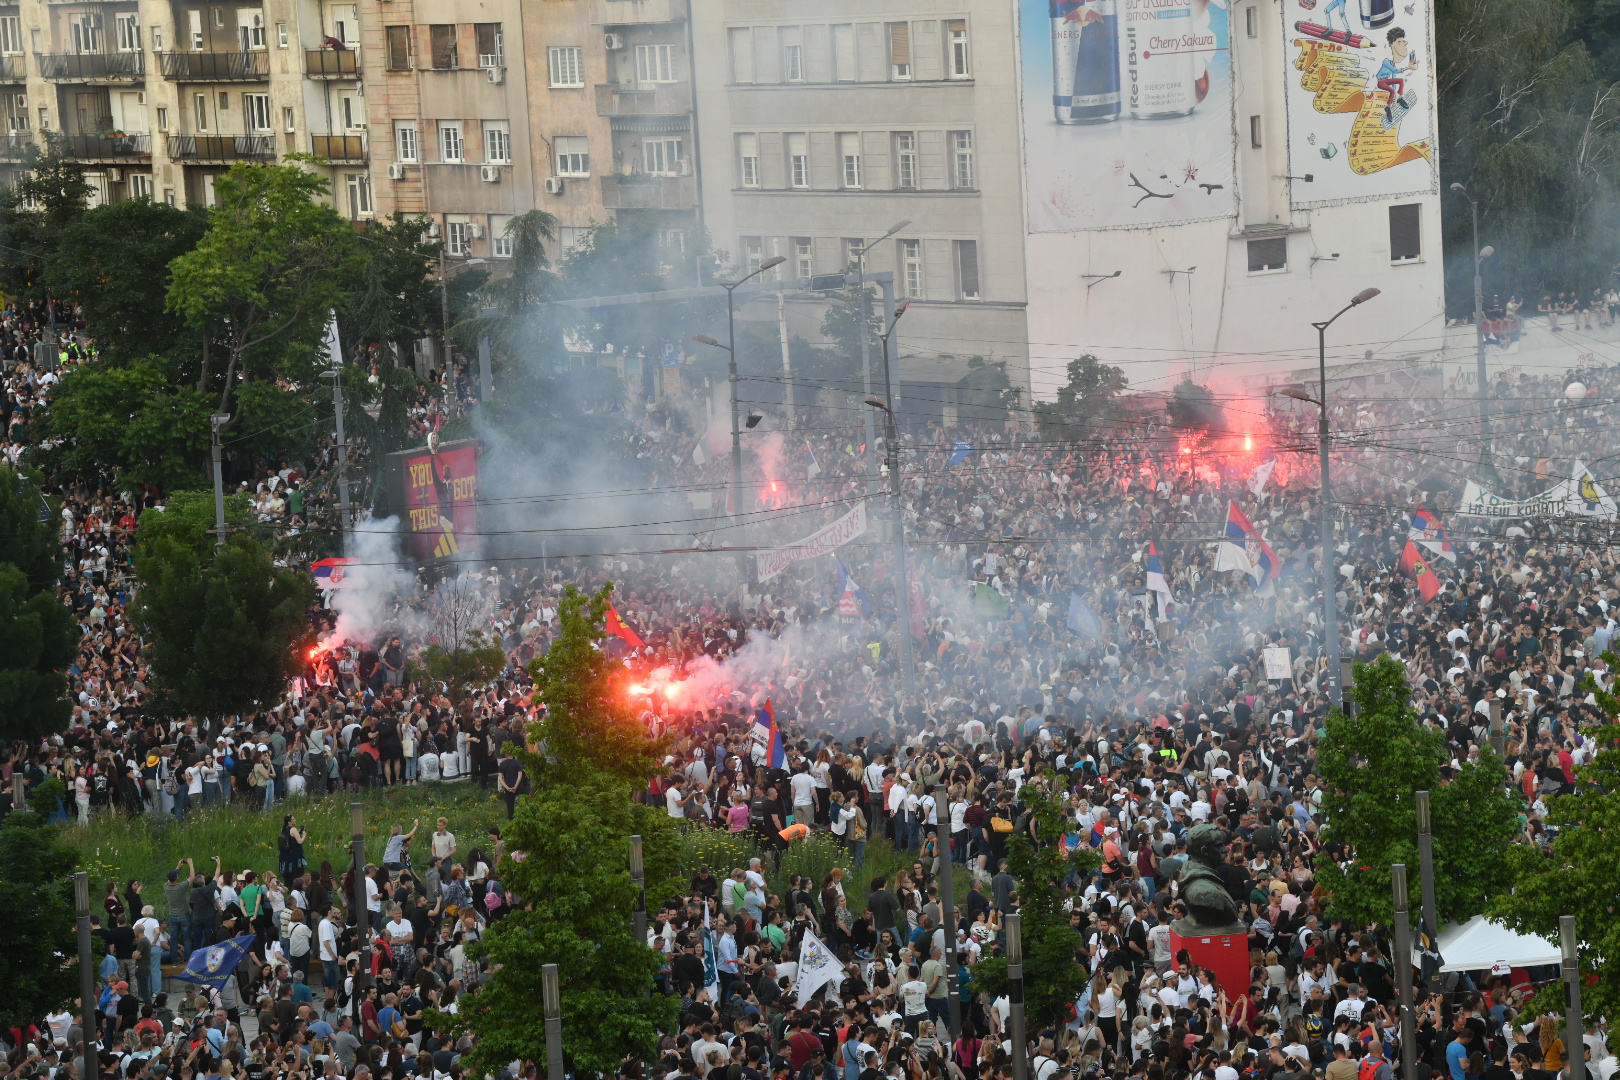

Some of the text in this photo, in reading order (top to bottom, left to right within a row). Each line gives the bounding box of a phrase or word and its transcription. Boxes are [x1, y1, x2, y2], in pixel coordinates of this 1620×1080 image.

[1126, 11, 1156, 22] EDITION
[1150, 33, 1214, 50] Cherry Sakura
[1127, 28, 1139, 108] Red Bull
[1144, 83, 1165, 91] ENERGY
[665, 343, 674, 357] P
[409, 463, 434, 489] YOU
[453, 475, 476, 500] GOT
[409, 505, 438, 532] THIS
